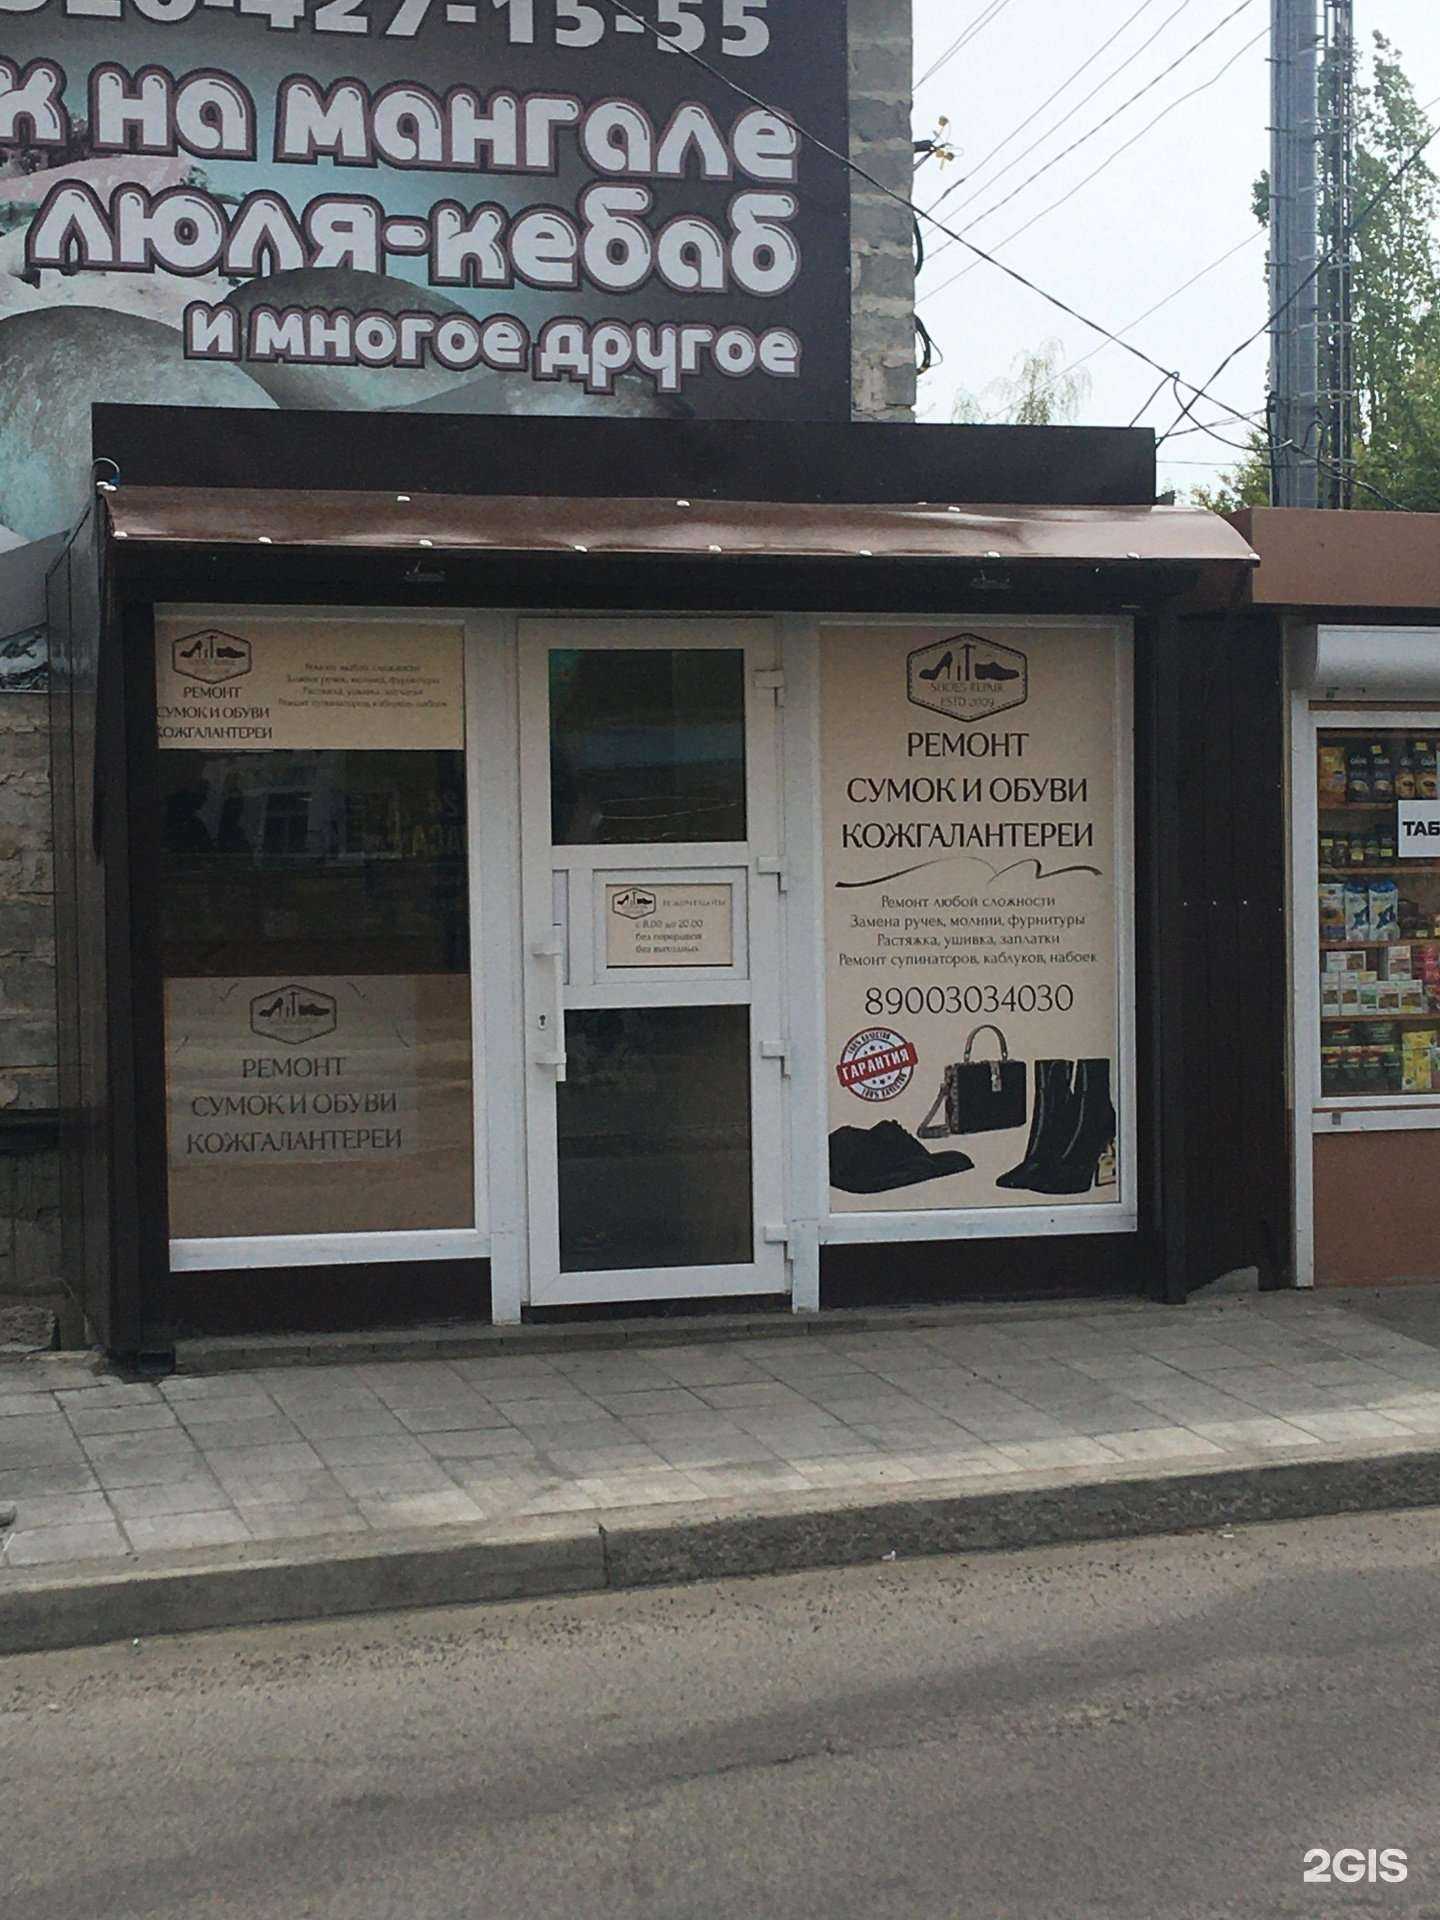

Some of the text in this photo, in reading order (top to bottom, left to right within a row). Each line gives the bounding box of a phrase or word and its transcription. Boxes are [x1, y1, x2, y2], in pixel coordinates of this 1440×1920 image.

[93, 67, 253, 156] на
[279, 79, 797, 179] мангале
[31, 182, 797, 291] люля-кебаб
[186, 303, 799, 392] и многое другое
[183, 687, 241, 699] РЕМОНТ
[210, 707, 220, 718] И
[223, 706, 270, 719] ОБУВИ
[907, 733, 1029, 757] РЕМОНТ
[847, 778, 1088, 803] СУМОК И ОБУВИ
[842, 822, 1093, 848] КОЖГАЛАНТЕРЕИ
[881, 895, 1056, 908] Ремонт любой сложности
[850, 914, 900, 928] Замена
[1007, 914, 1086, 928] фурнитуры
[999, 934, 1060, 945] заплатки
[839, 953, 887, 967] Ремонт
[1049, 951, 1098, 963] набоек
[864, 984, 1074, 1015] 89003034030
[242, 1056, 347, 1079] РЕМОНТ
[841, 1048, 910, 1081] ГАРАНТИЯ
[191, 1092, 397, 1117] СУМОК И ОБУВИ
[186, 1128, 402, 1155] КОЖГАЛАНТЕРЕИ
